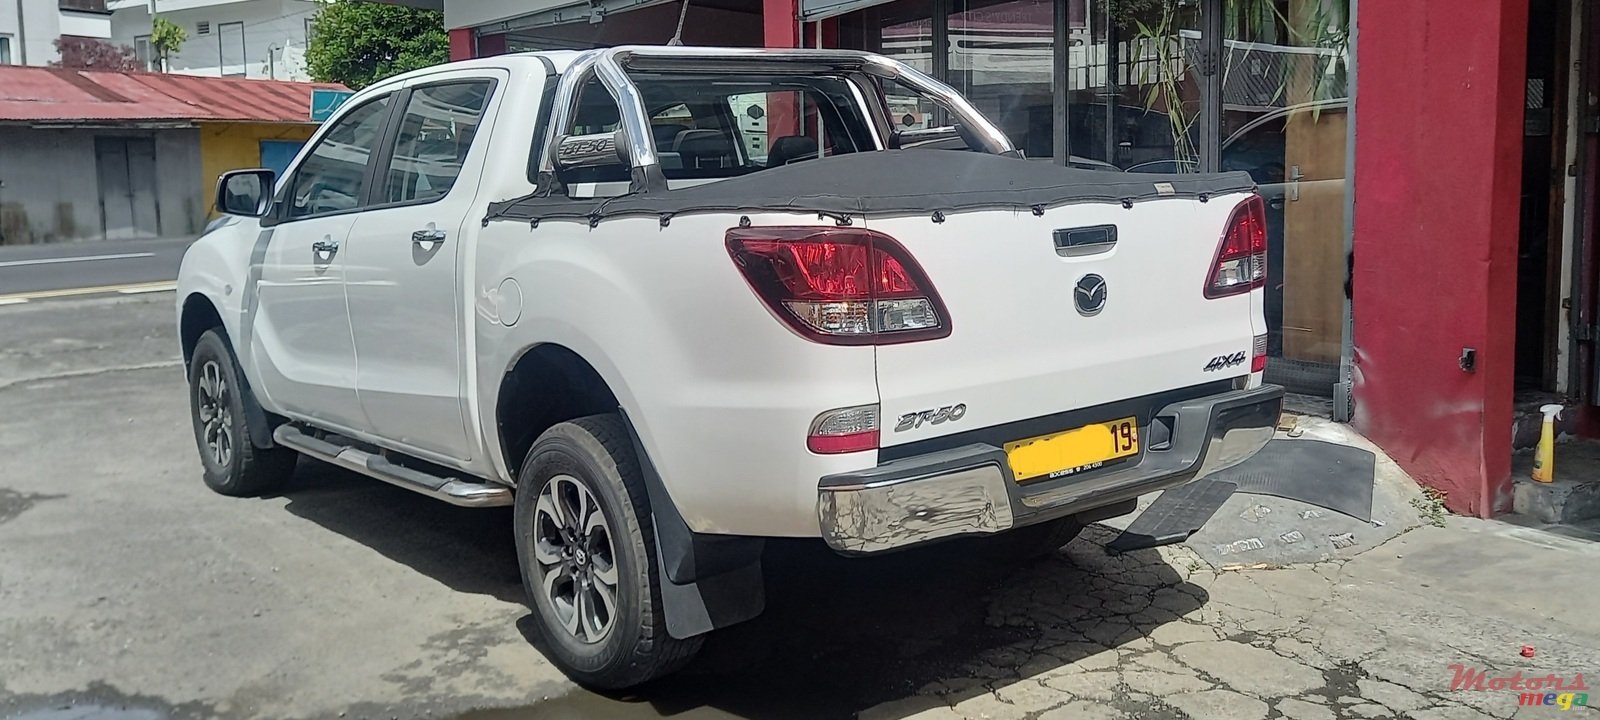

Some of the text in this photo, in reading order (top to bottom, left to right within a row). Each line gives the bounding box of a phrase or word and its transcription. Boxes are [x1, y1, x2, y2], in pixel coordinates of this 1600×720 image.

[563, 138, 607, 155] BT-50
[894, 403, 967, 432] BT-50
[1110, 421, 1132, 453] 19
